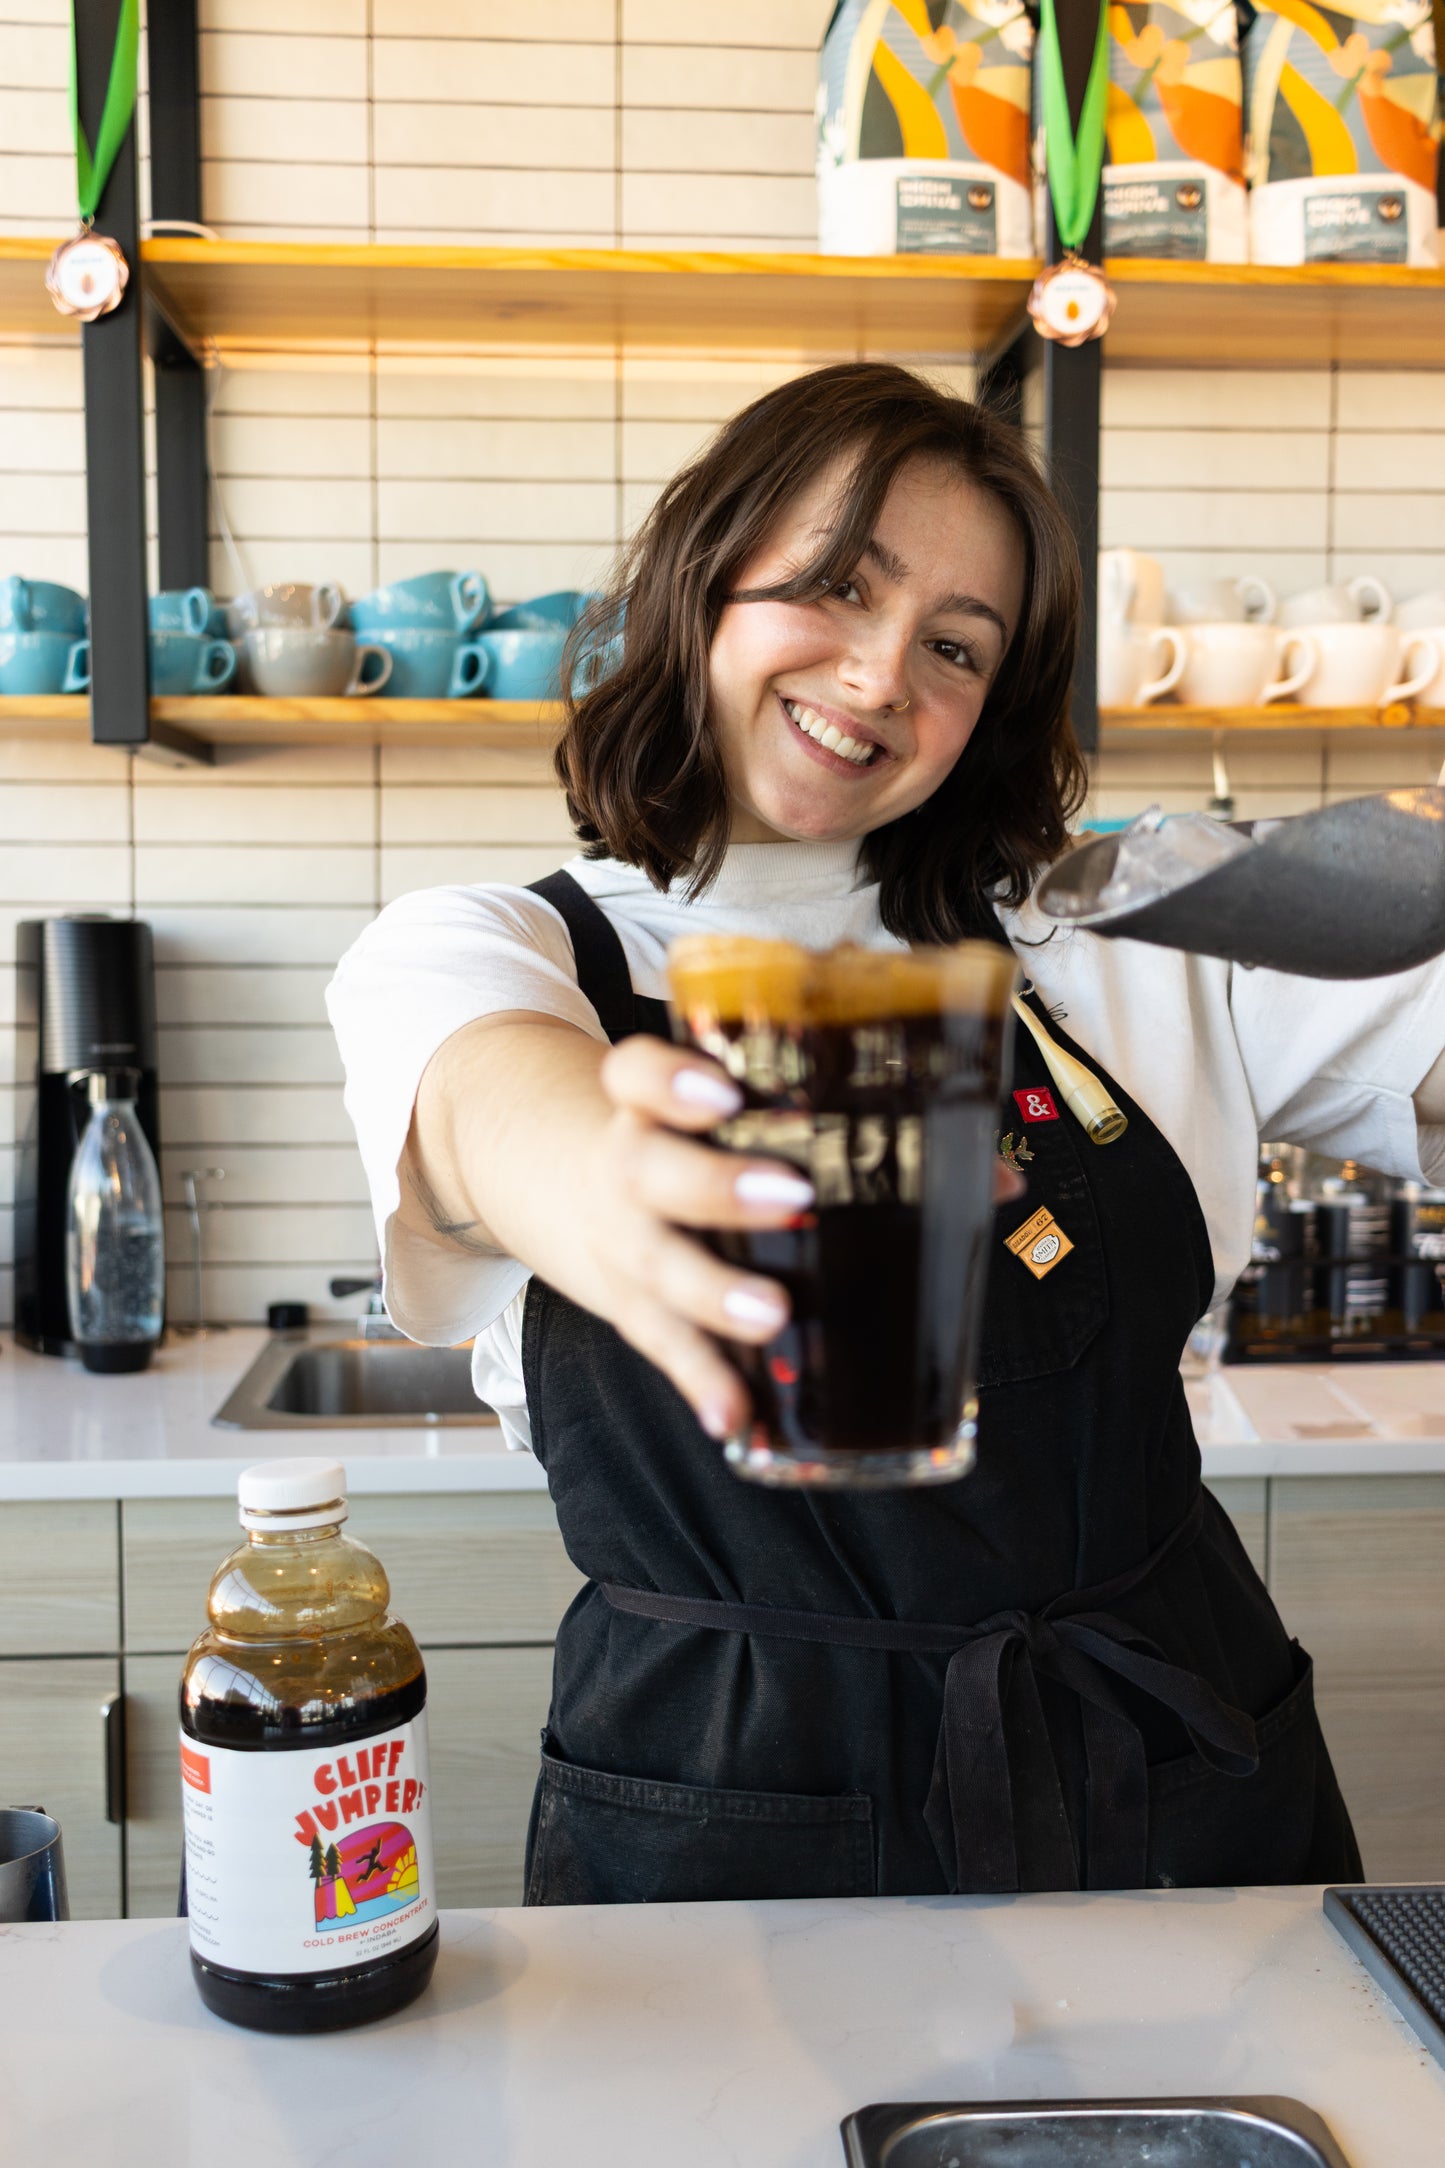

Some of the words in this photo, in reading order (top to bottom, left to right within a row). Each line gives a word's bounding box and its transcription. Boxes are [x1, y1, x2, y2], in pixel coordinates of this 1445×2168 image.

[899, 180, 951, 195] HIGH
[899, 194, 961, 210] DRIVE
[1026, 1094, 1050, 1116] &
[1036, 1213, 1048, 1226] 67
[1035, 1239, 1057, 1260] SMITH
[314, 1740, 405, 1795] CLIFF
[303, 1937, 334, 1948] COLD
[338, 1928, 370, 1943] BREW
[372, 1898, 428, 1934] CONCENTRATE
[367, 1927, 397, 1943] INDABA
